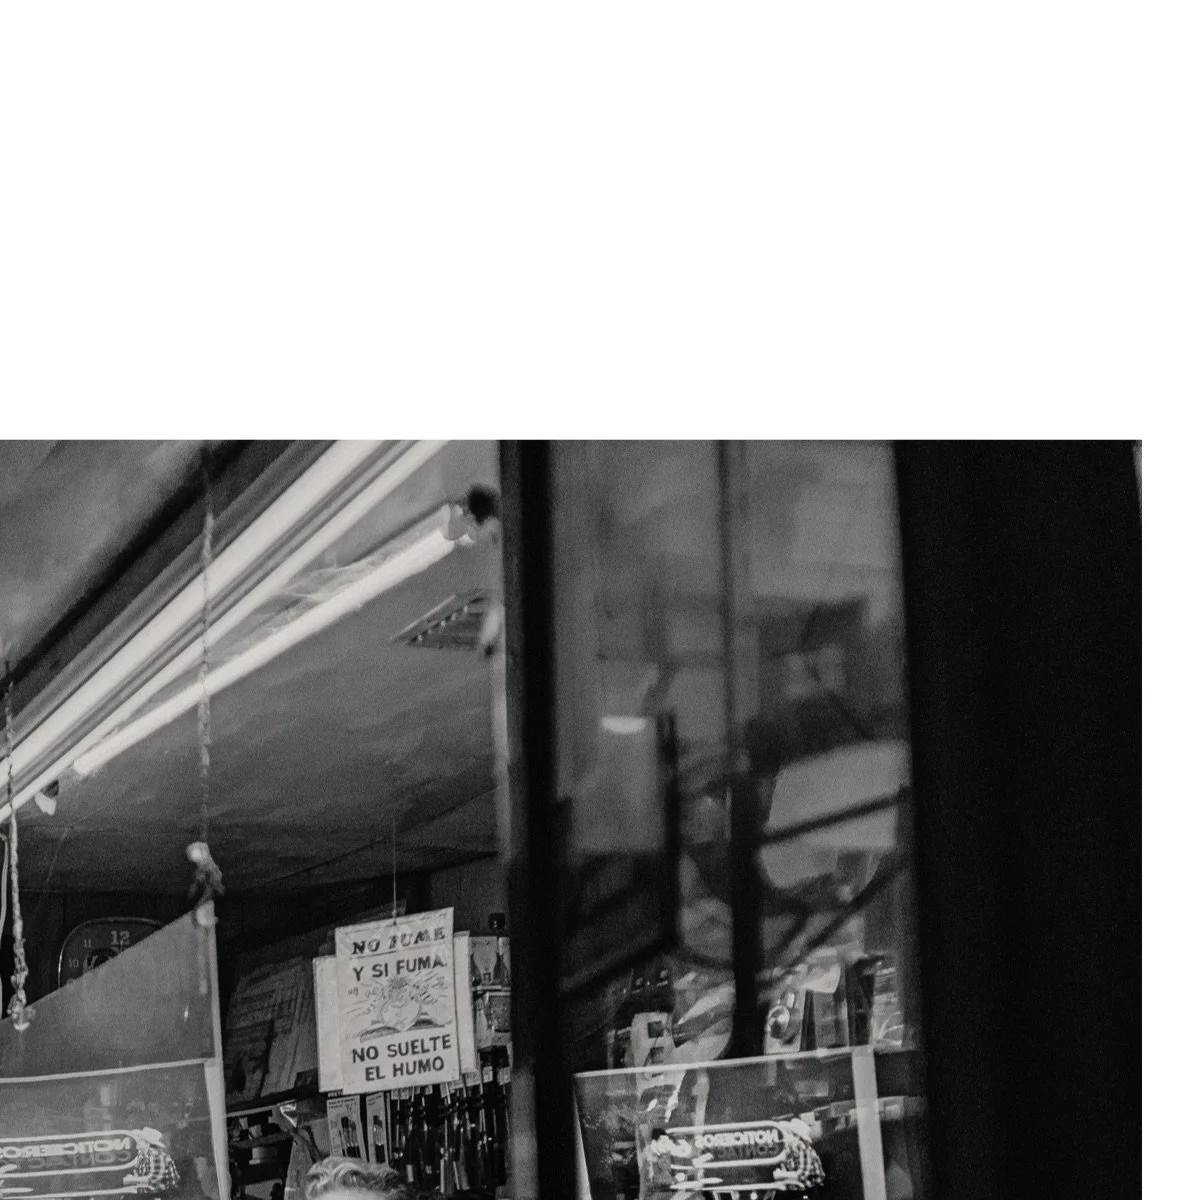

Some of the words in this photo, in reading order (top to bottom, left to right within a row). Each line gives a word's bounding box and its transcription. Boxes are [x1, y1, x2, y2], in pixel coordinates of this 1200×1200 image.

[110, 930, 131, 946] 12
[352, 938, 380, 955] NO
[353, 966, 365, 982] Y
[372, 963, 388, 978] SI
[352, 1046, 379, 1063] NO
[387, 1034, 452, 1058] SUELTE
[365, 1066, 386, 1082] EL
[392, 1056, 445, 1077] HUMO
